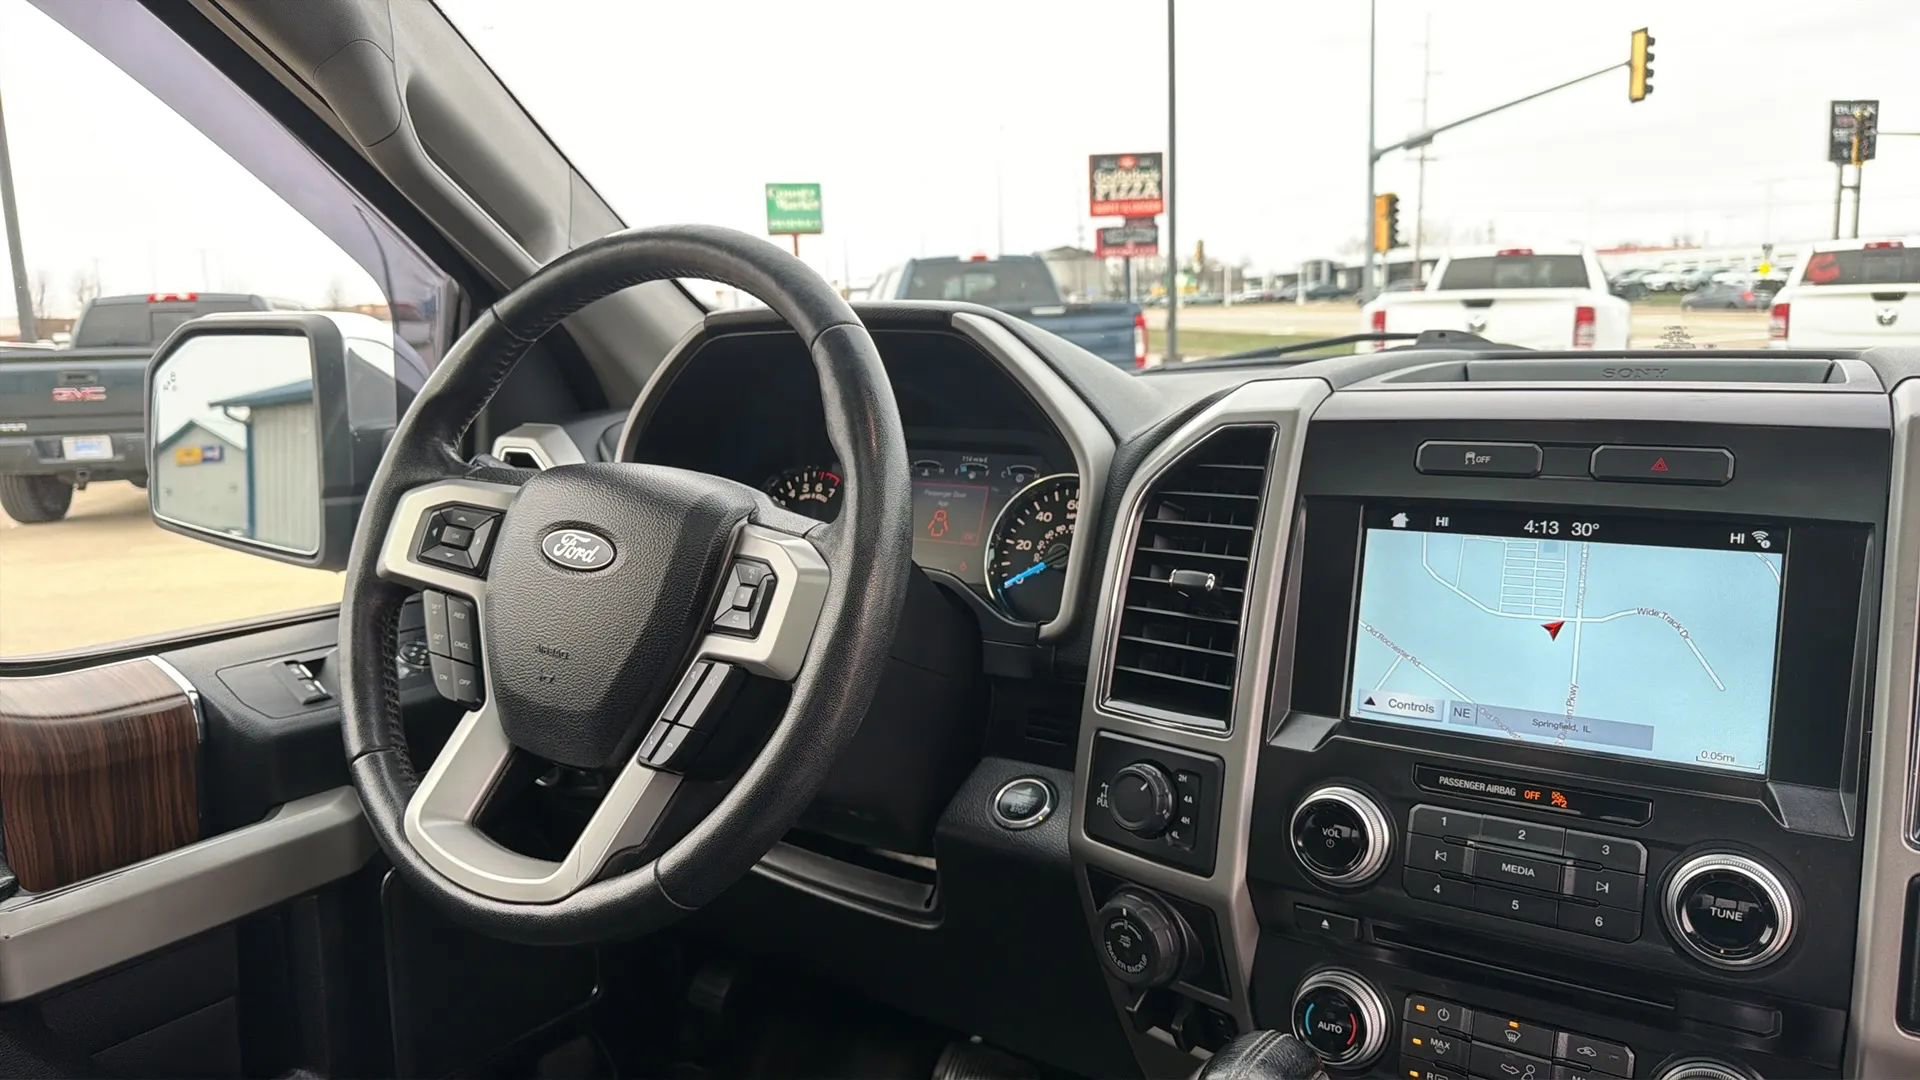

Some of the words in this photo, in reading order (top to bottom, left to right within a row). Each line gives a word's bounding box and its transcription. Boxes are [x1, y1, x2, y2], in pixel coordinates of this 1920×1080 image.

[1095, 182, 1161, 201] PIZZA
[1602, 367, 1669, 379] SONY
[52, 386, 107, 401] GMC
[1475, 455, 1491, 464] OFF
[801, 482, 810, 493] 5
[814, 482, 823, 493] 6
[828, 487, 836, 498] 7
[1035, 511, 1053, 522] 40
[1435, 516, 1449, 527] HI
[1523, 519, 1560, 535] 4:13
[1730, 532, 1745, 545] HI
[552, 533, 601, 563] Ford
[1015, 539, 1032, 551] 20
[1636, 607, 1659, 617] Wide
[1661, 611, 1682, 631] Track
[1680, 629, 1690, 640] Dr
[1410, 656, 1421, 667] Rd
[458, 678, 472, 686] OFF
[1388, 698, 1435, 714] Controls
[1453, 707, 1471, 718] NE
[1583, 725, 1592, 734] IL
[1438, 775, 1486, 792] PASSENGER
[1486, 783, 1517, 797] AIRBAG
[1523, 789, 1542, 800] OFF
[1440, 816, 1448, 827] 1
[1322, 827, 1341, 838] VOL
[1518, 830, 1526, 840] 2
[1602, 845, 1610, 855] 3
[1501, 862, 1536, 878] MEDIA
[1433, 884, 1441, 894] 4
[1512, 900, 1519, 910] 5
[1709, 906, 1744, 922] TUNE
[1594, 916, 1604, 927] 6
[1105, 940, 1127, 971] TRAILER
[1126, 953, 1148, 973] BACKUP
[1317, 1020, 1343, 1034] AUTO
[1430, 1038, 1450, 1050] MAX
